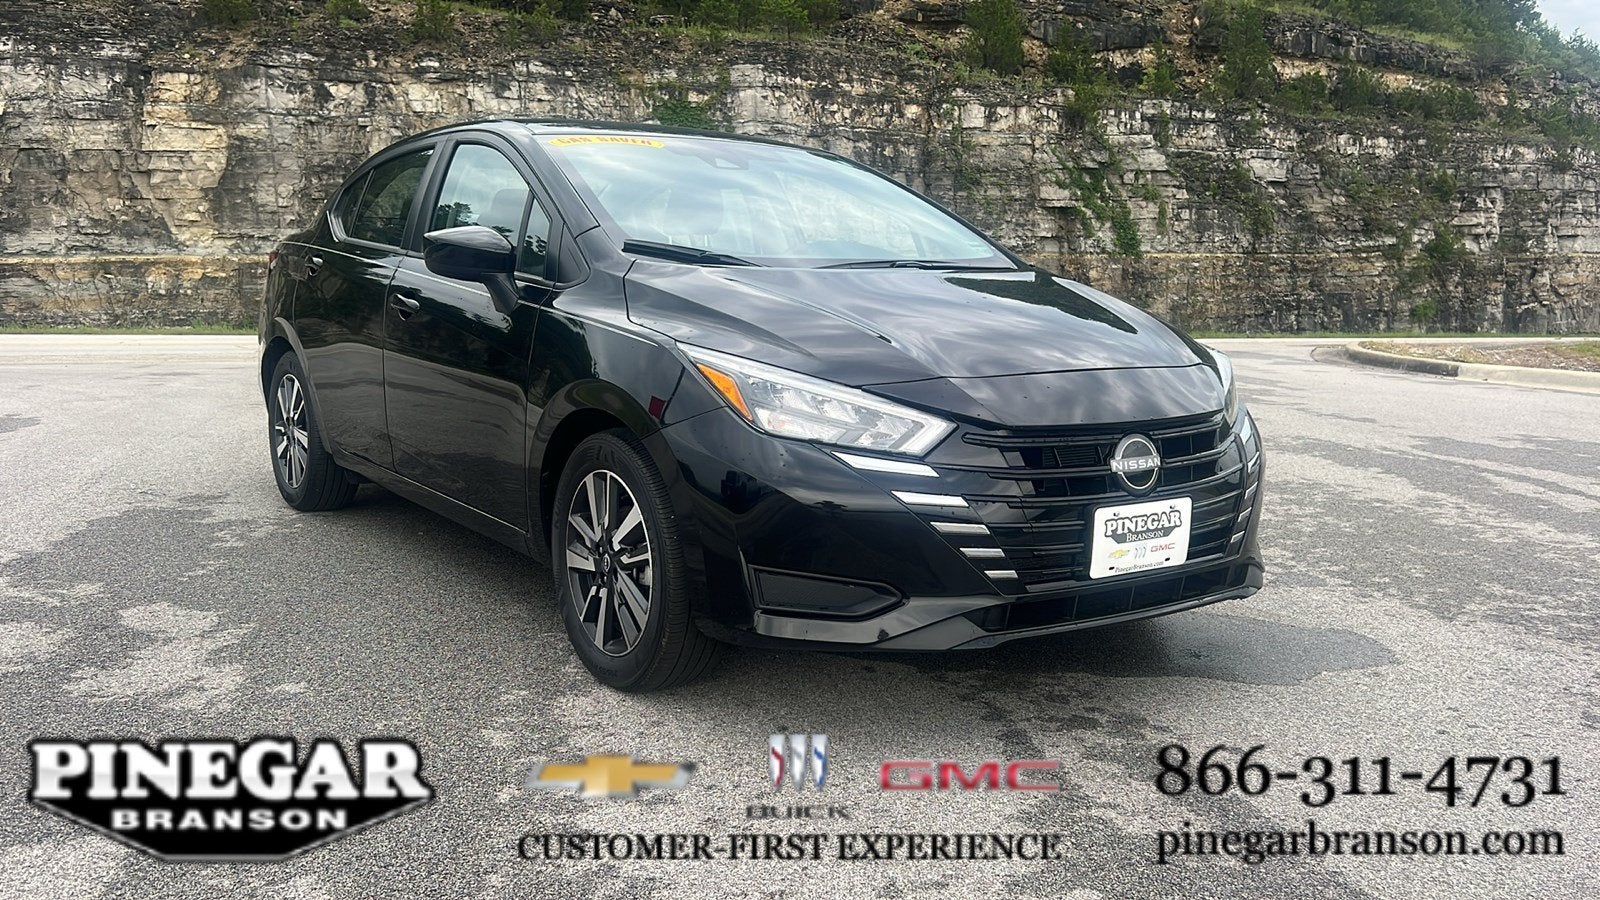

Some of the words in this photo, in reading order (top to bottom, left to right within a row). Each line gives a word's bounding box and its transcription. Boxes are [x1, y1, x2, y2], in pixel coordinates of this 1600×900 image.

[1112, 457, 1161, 471] NISSAN
[1105, 510, 1182, 537] PINEGAR
[1126, 530, 1164, 543] BRANSON
[1151, 542, 1175, 553] GMC
